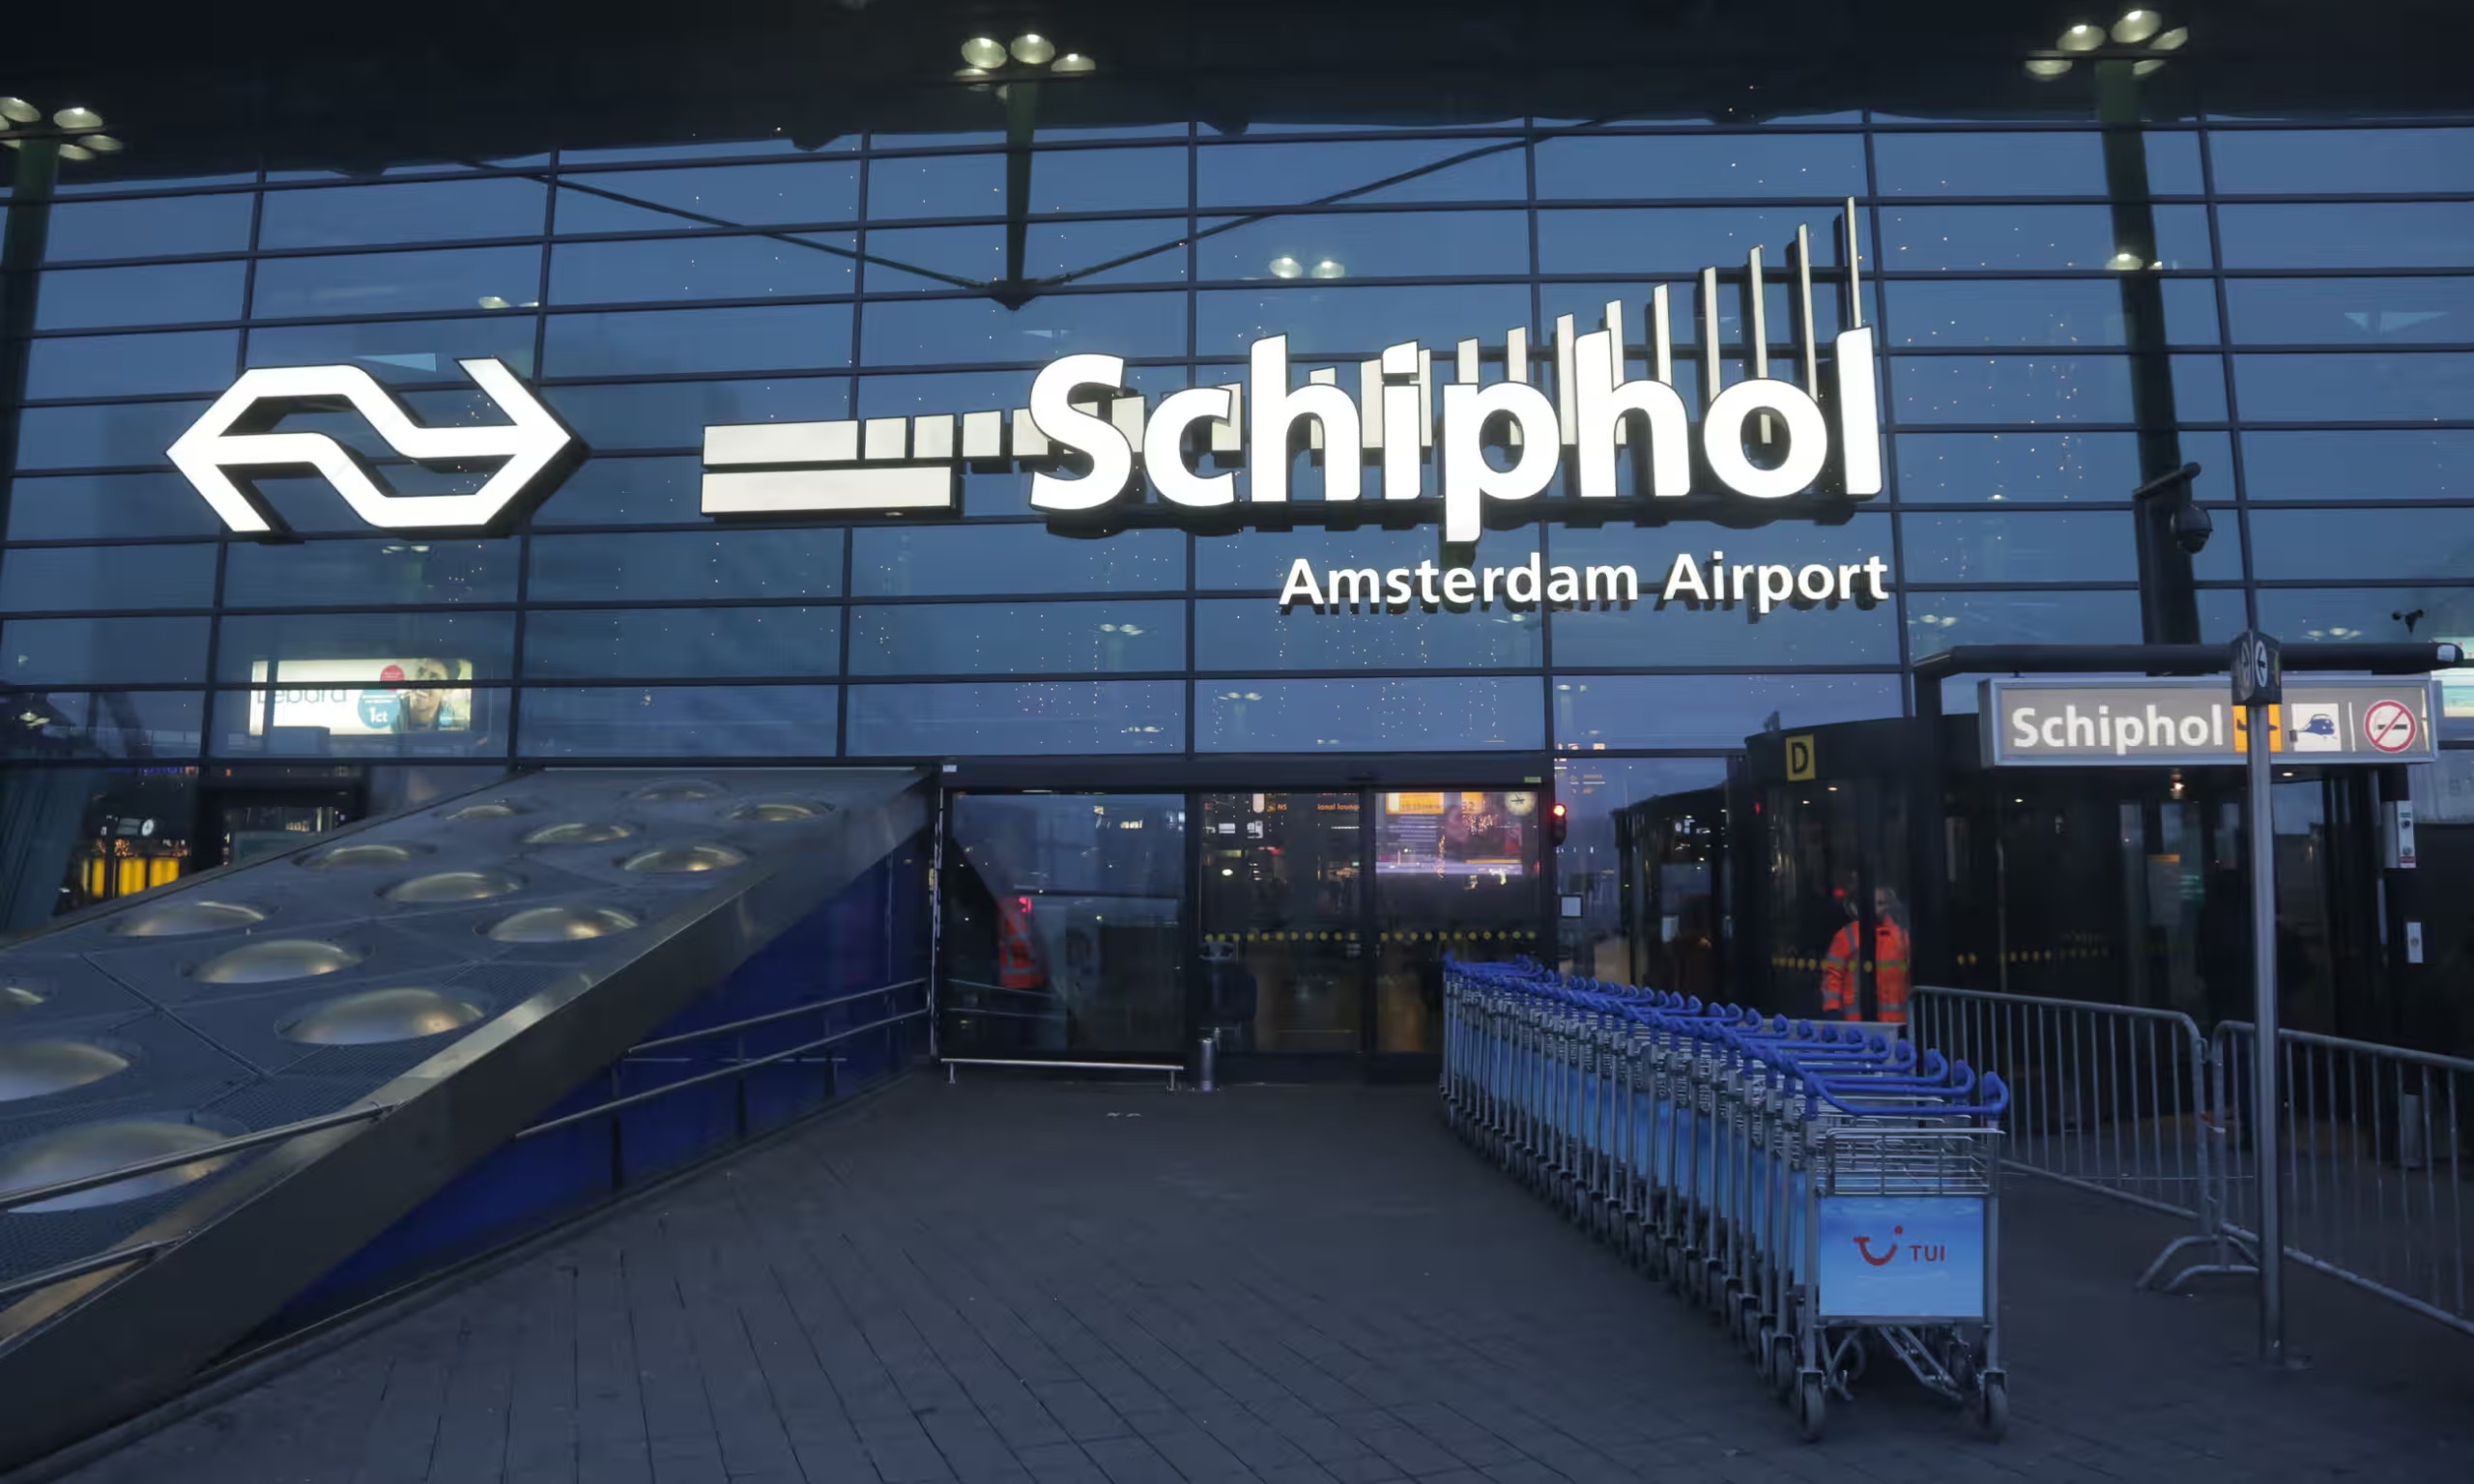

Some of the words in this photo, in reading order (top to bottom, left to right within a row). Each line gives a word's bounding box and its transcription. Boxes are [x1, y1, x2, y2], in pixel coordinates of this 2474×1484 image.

[1029, 326, 1884, 544] Schiphol
[1279, 553, 1639, 607] Amsterdam
[1662, 551, 1889, 614] Airport
[2011, 702, 2223, 756] Schiphol
[1792, 741, 1809, 775] D
[1909, 1245, 1945, 1262] TUI
